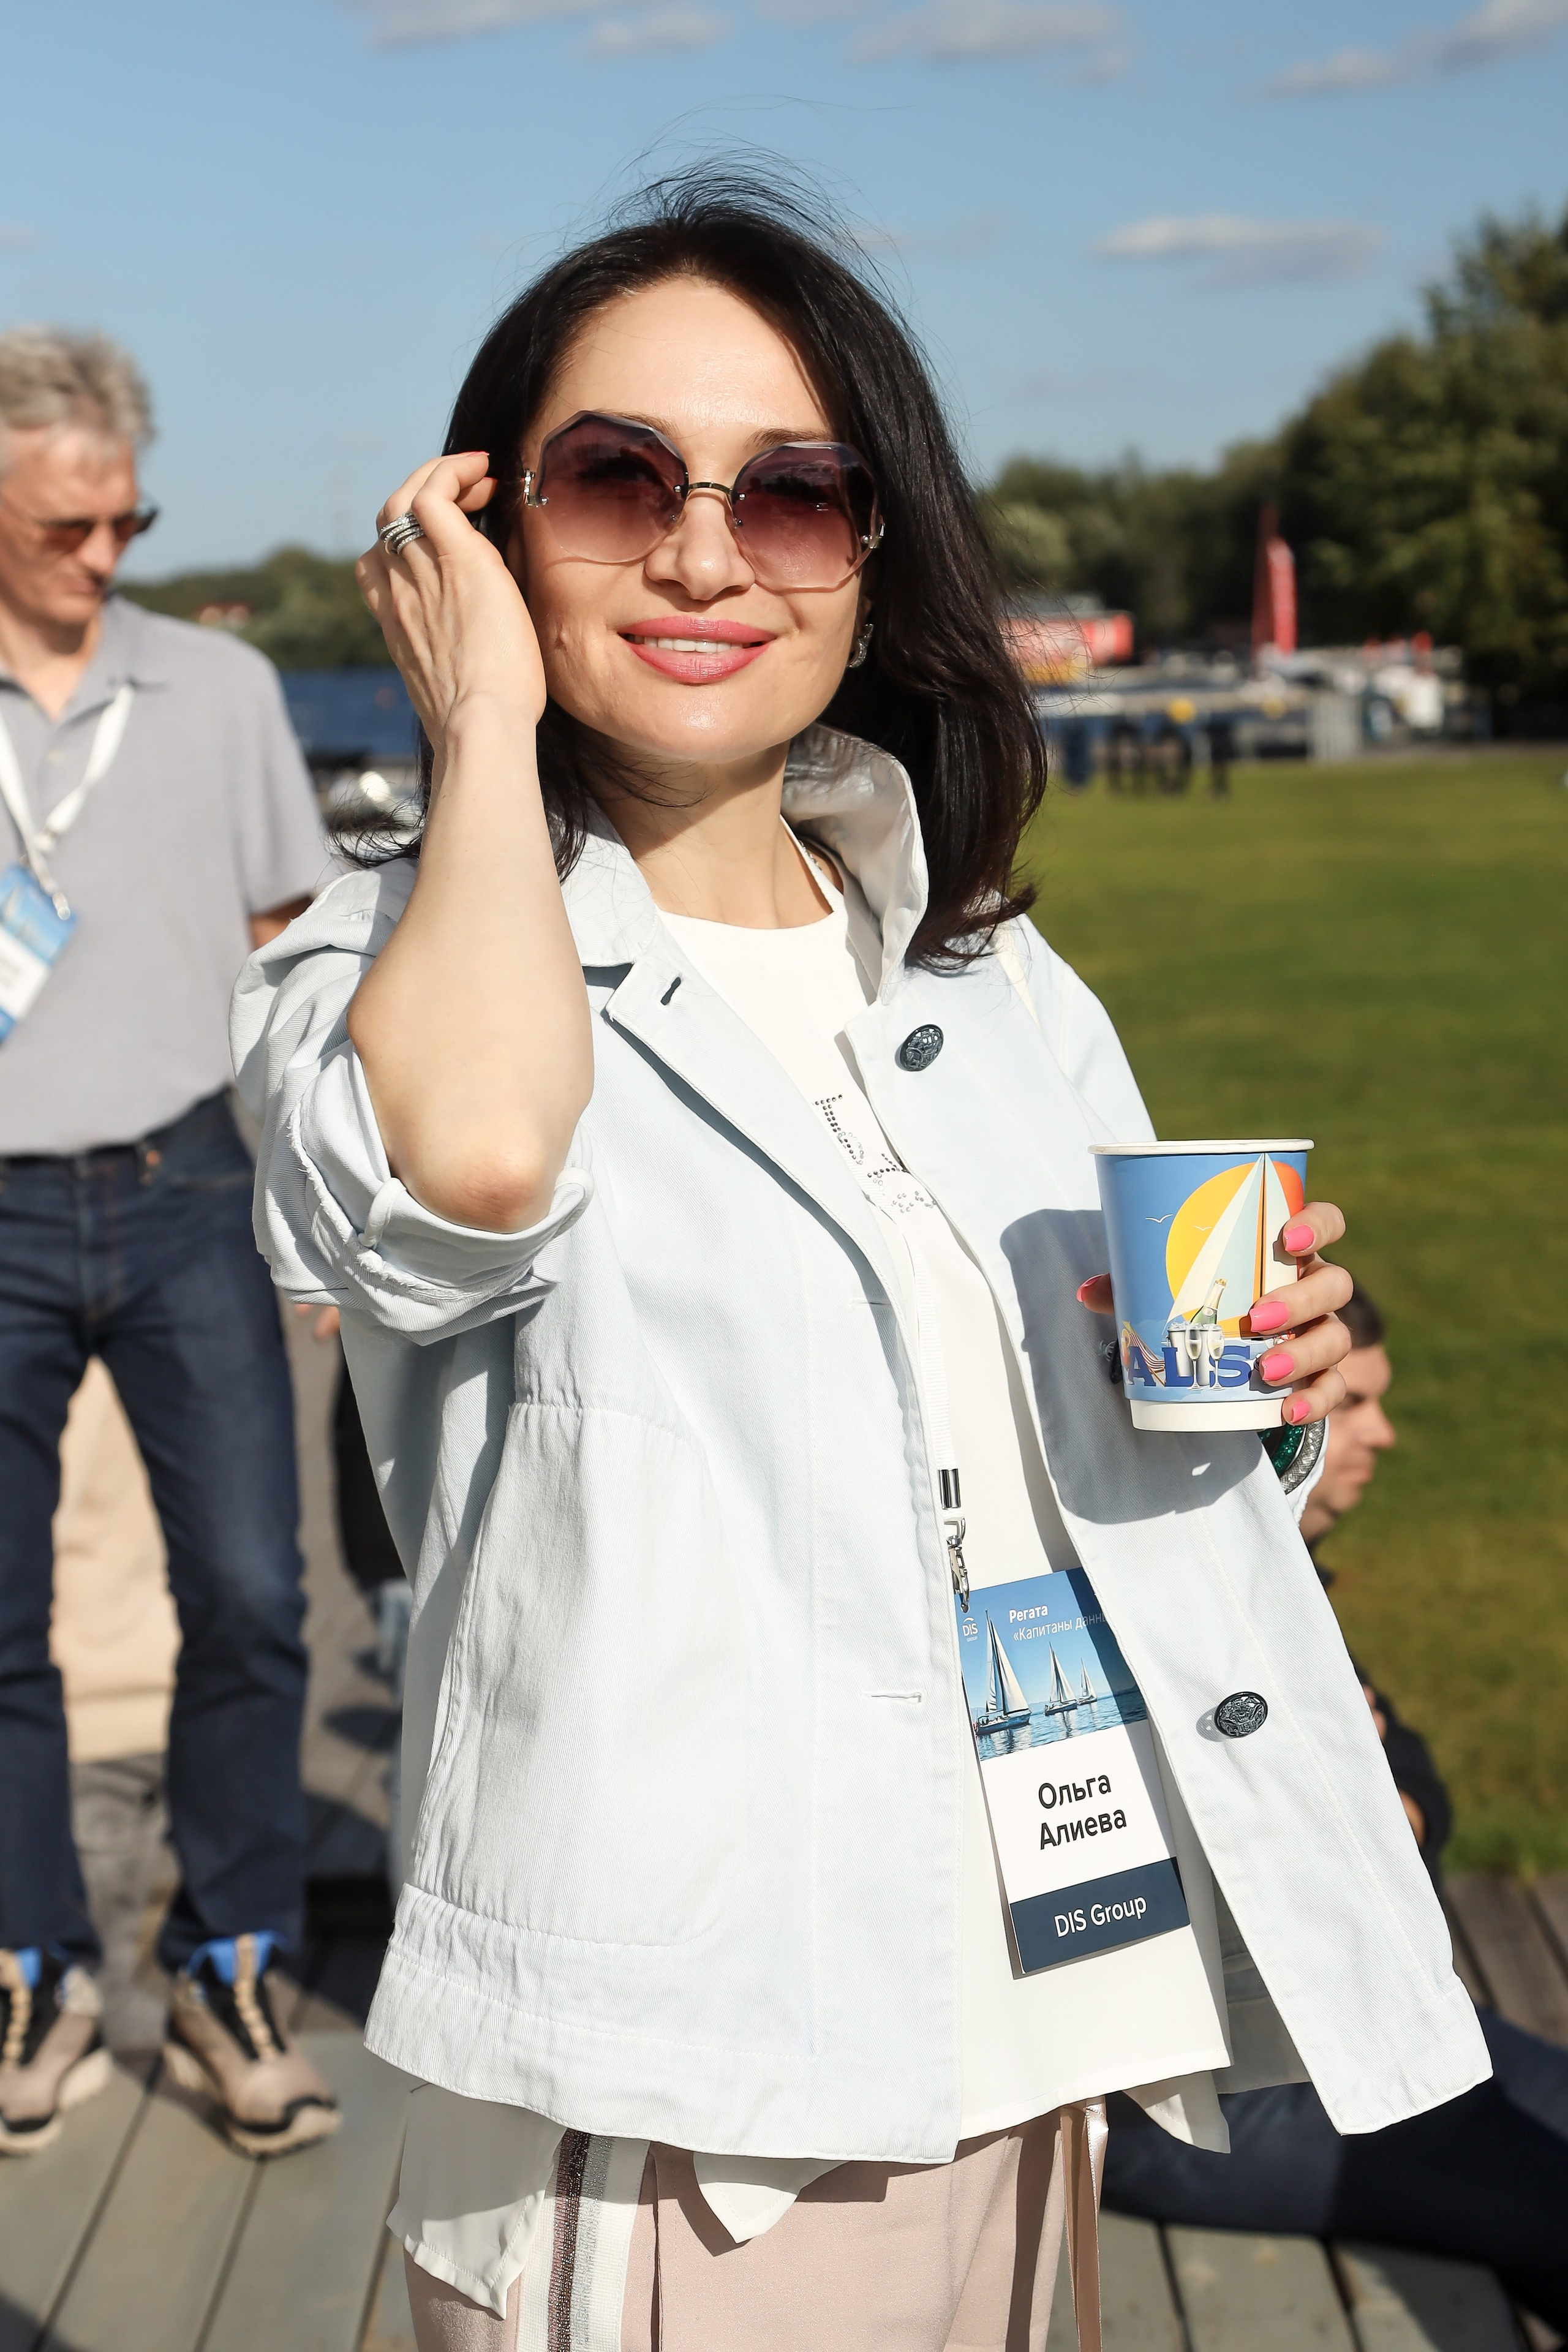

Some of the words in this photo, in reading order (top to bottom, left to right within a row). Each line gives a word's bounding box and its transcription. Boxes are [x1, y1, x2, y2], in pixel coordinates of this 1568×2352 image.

[1009, 1605, 1048, 1624] Регата
[962, 1623, 978, 1637] DIS
[1013, 1619, 1072, 1642] «Капитаны
[1038, 1774, 1112, 1809] Ольга
[1040, 1809, 1127, 1850] Алиева
[1054, 1909, 1087, 1938] DIS
[1090, 1896, 1147, 1926] Group
